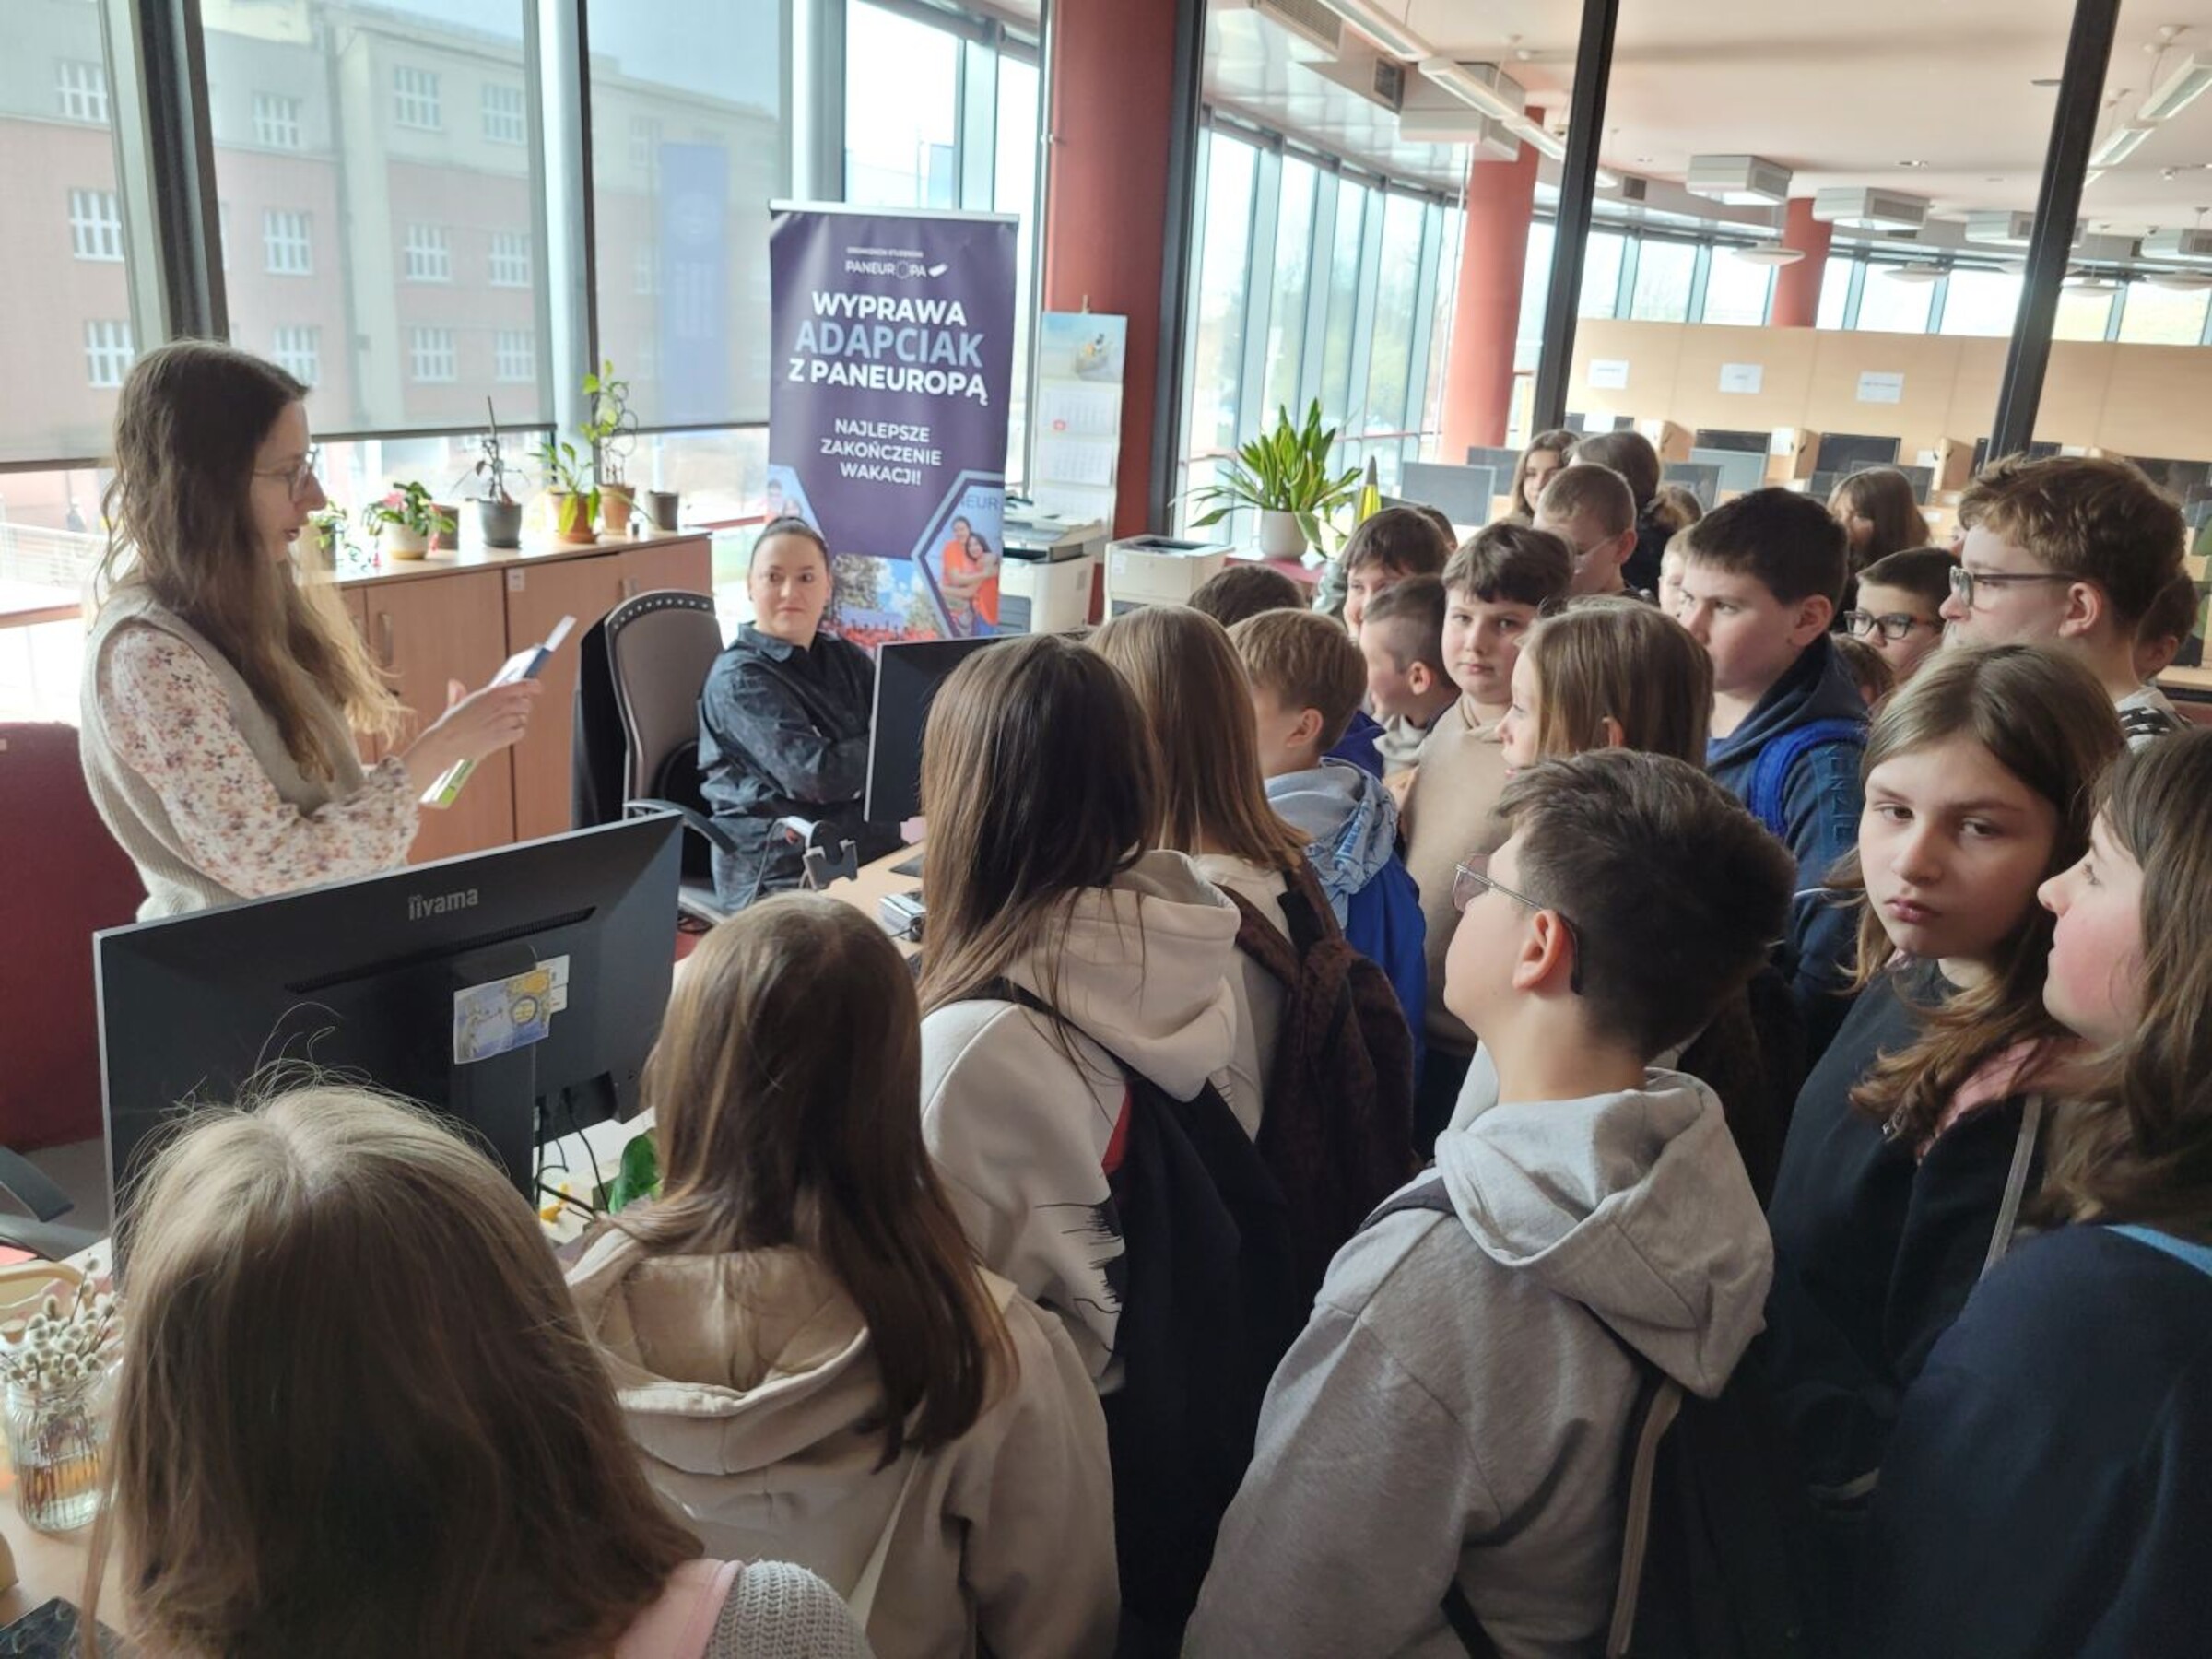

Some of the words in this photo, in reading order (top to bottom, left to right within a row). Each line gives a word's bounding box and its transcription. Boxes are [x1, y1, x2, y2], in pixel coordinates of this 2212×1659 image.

[812, 291, 967, 326] WYPRAWA
[794, 320, 984, 368] ADAPCIAK
[788, 358, 805, 382] Z
[810, 359, 988, 406] PANEUROPĄ
[835, 418, 930, 442] NAJLEPSZE
[820, 438, 942, 465] ZAKOŃCZENIE
[840, 462, 921, 486] WAKACJI!
[408, 889, 478, 921] iiyama
